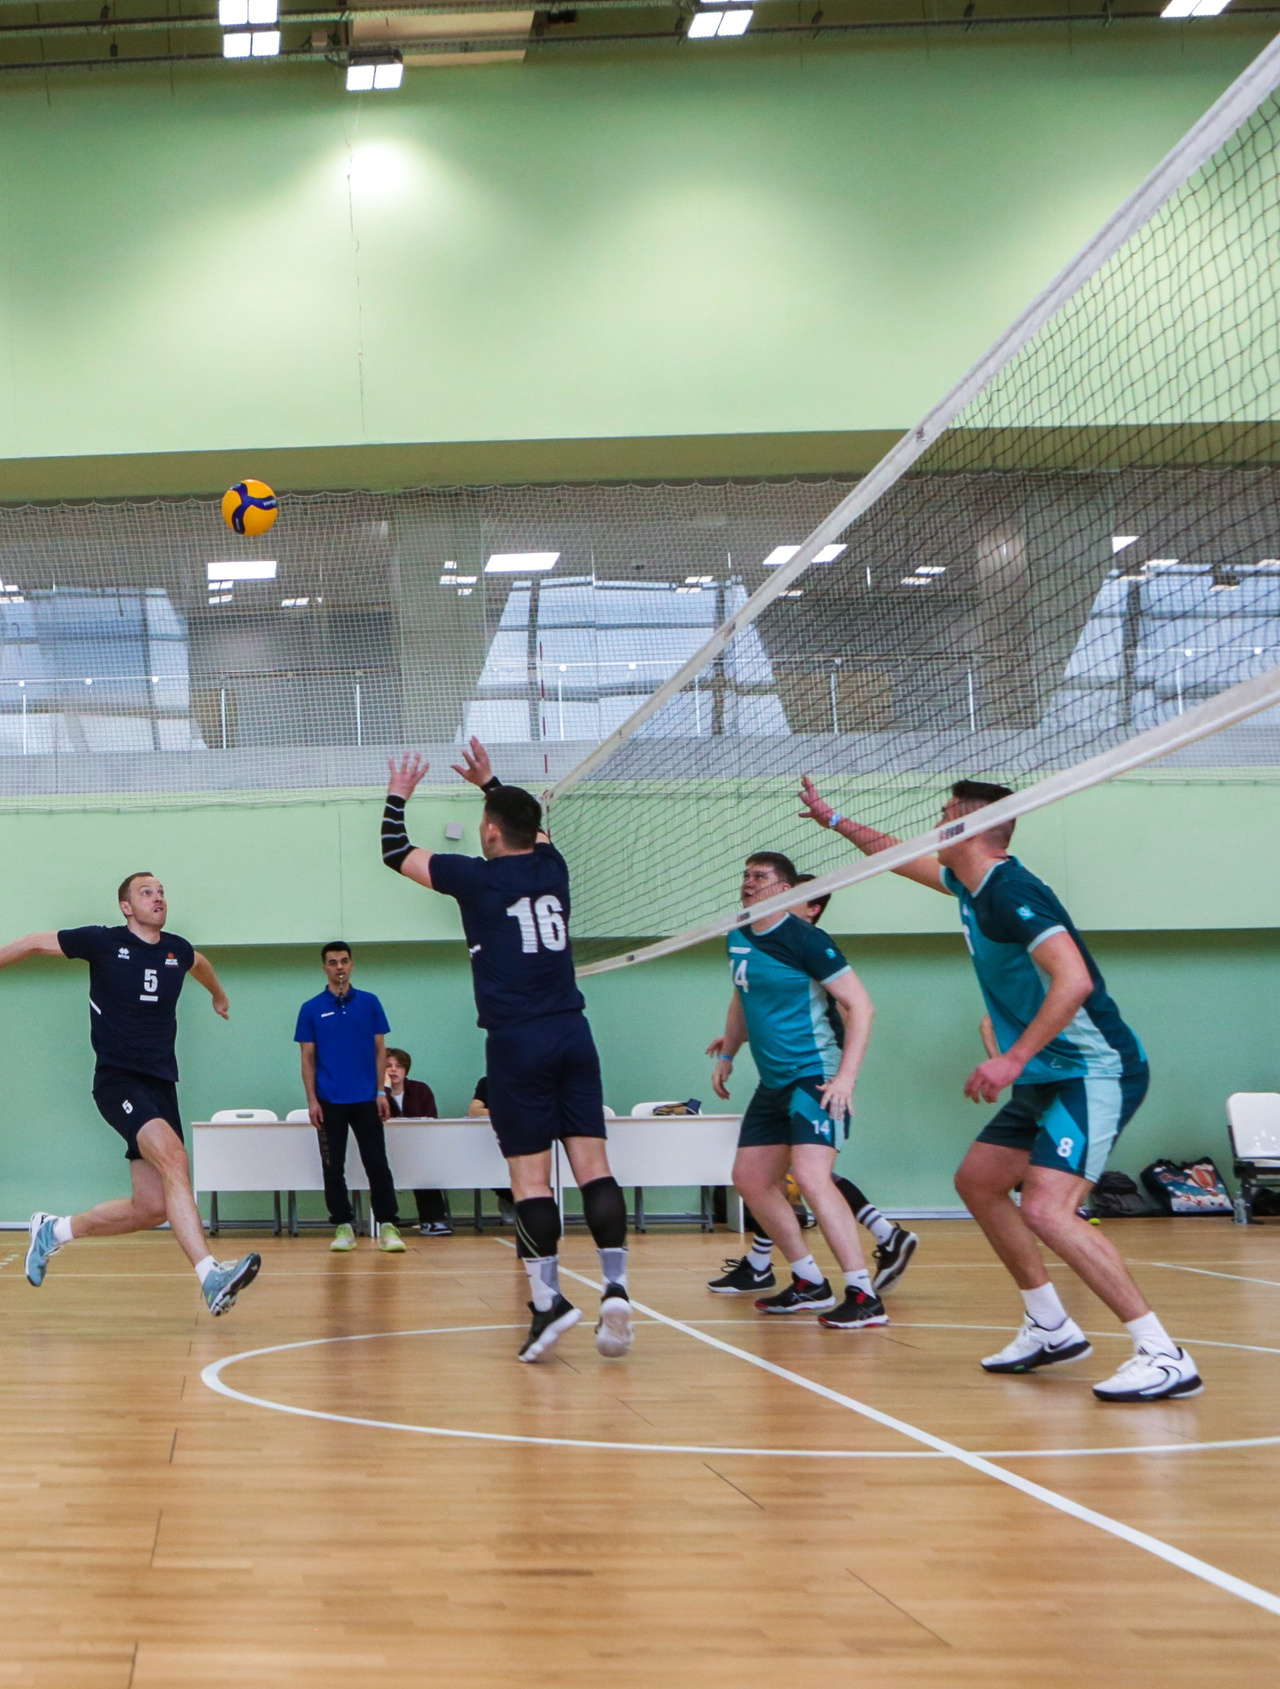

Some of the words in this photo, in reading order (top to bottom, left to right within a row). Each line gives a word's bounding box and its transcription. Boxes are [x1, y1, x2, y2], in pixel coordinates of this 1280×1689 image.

[506, 894, 567, 953] 16
[143, 968, 159, 992] 5
[122, 1100, 133, 1114] 5
[812, 1119, 830, 1135] 14
[1056, 1136, 1074, 1158] 8
